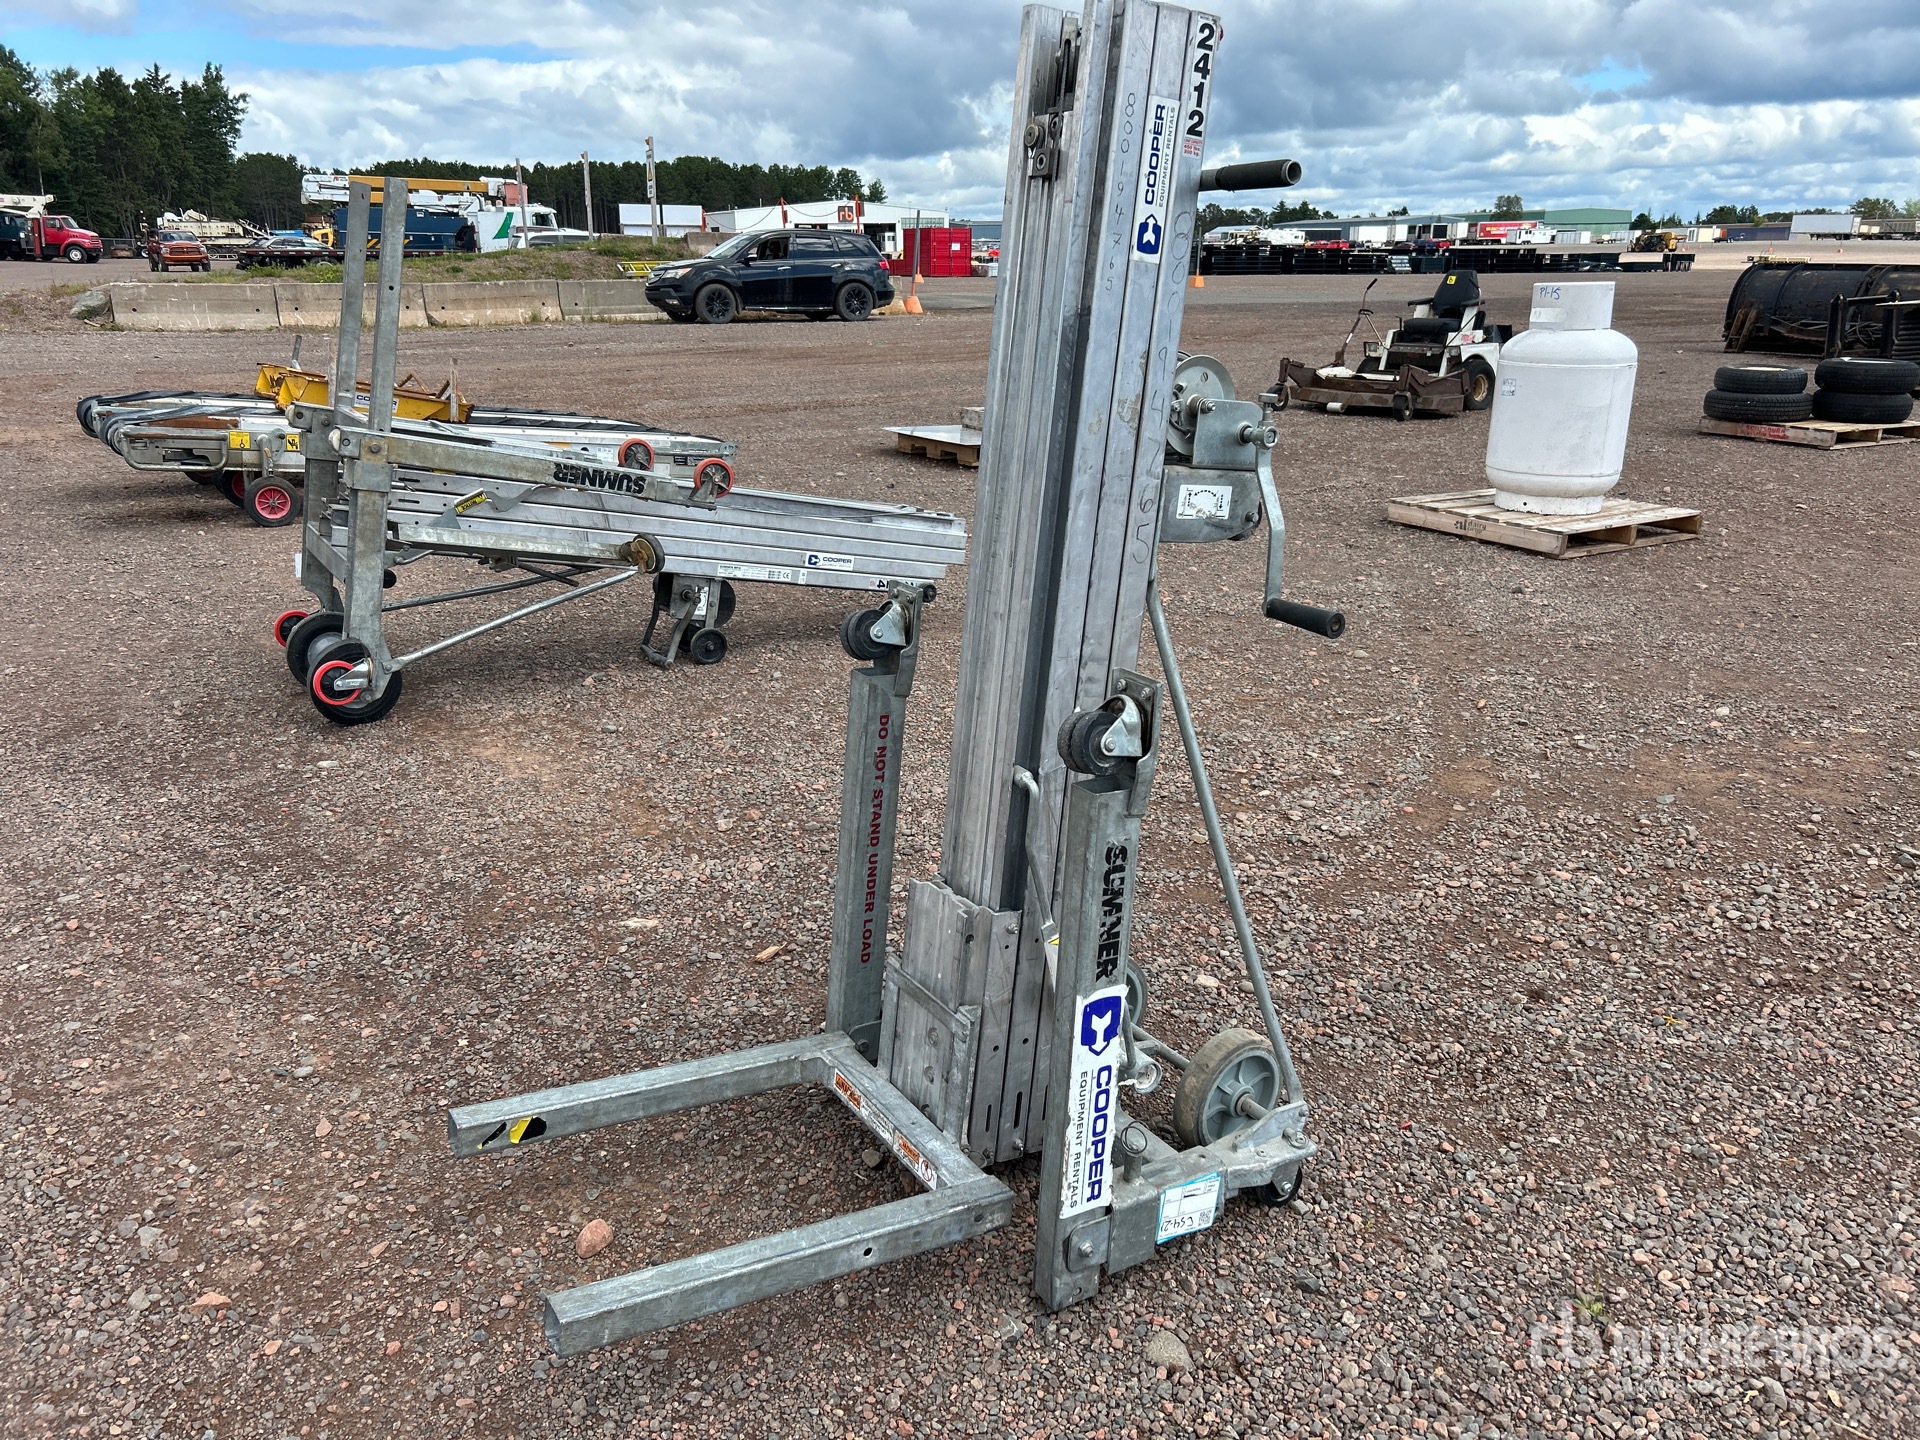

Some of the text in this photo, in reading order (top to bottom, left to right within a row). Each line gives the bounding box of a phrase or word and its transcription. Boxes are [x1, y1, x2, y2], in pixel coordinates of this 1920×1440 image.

[1186, 22, 1215, 138] 2412
[1144, 104, 1166, 206] COOPER
[1158, 106, 1176, 208] EQUIPMENT RENTALS
[850, 221, 873, 243] rb
[552, 462, 647, 496] SUMNER
[822, 556, 853, 565] COOPER
[860, 714, 891, 965] DO NOT STAND UNDER LOAD
[1096, 844, 1128, 983] SUMNER
[1069, 1070, 1089, 1210] EQUIPMENT RENTALS
[1086, 1063, 1113, 1203] COOPER
